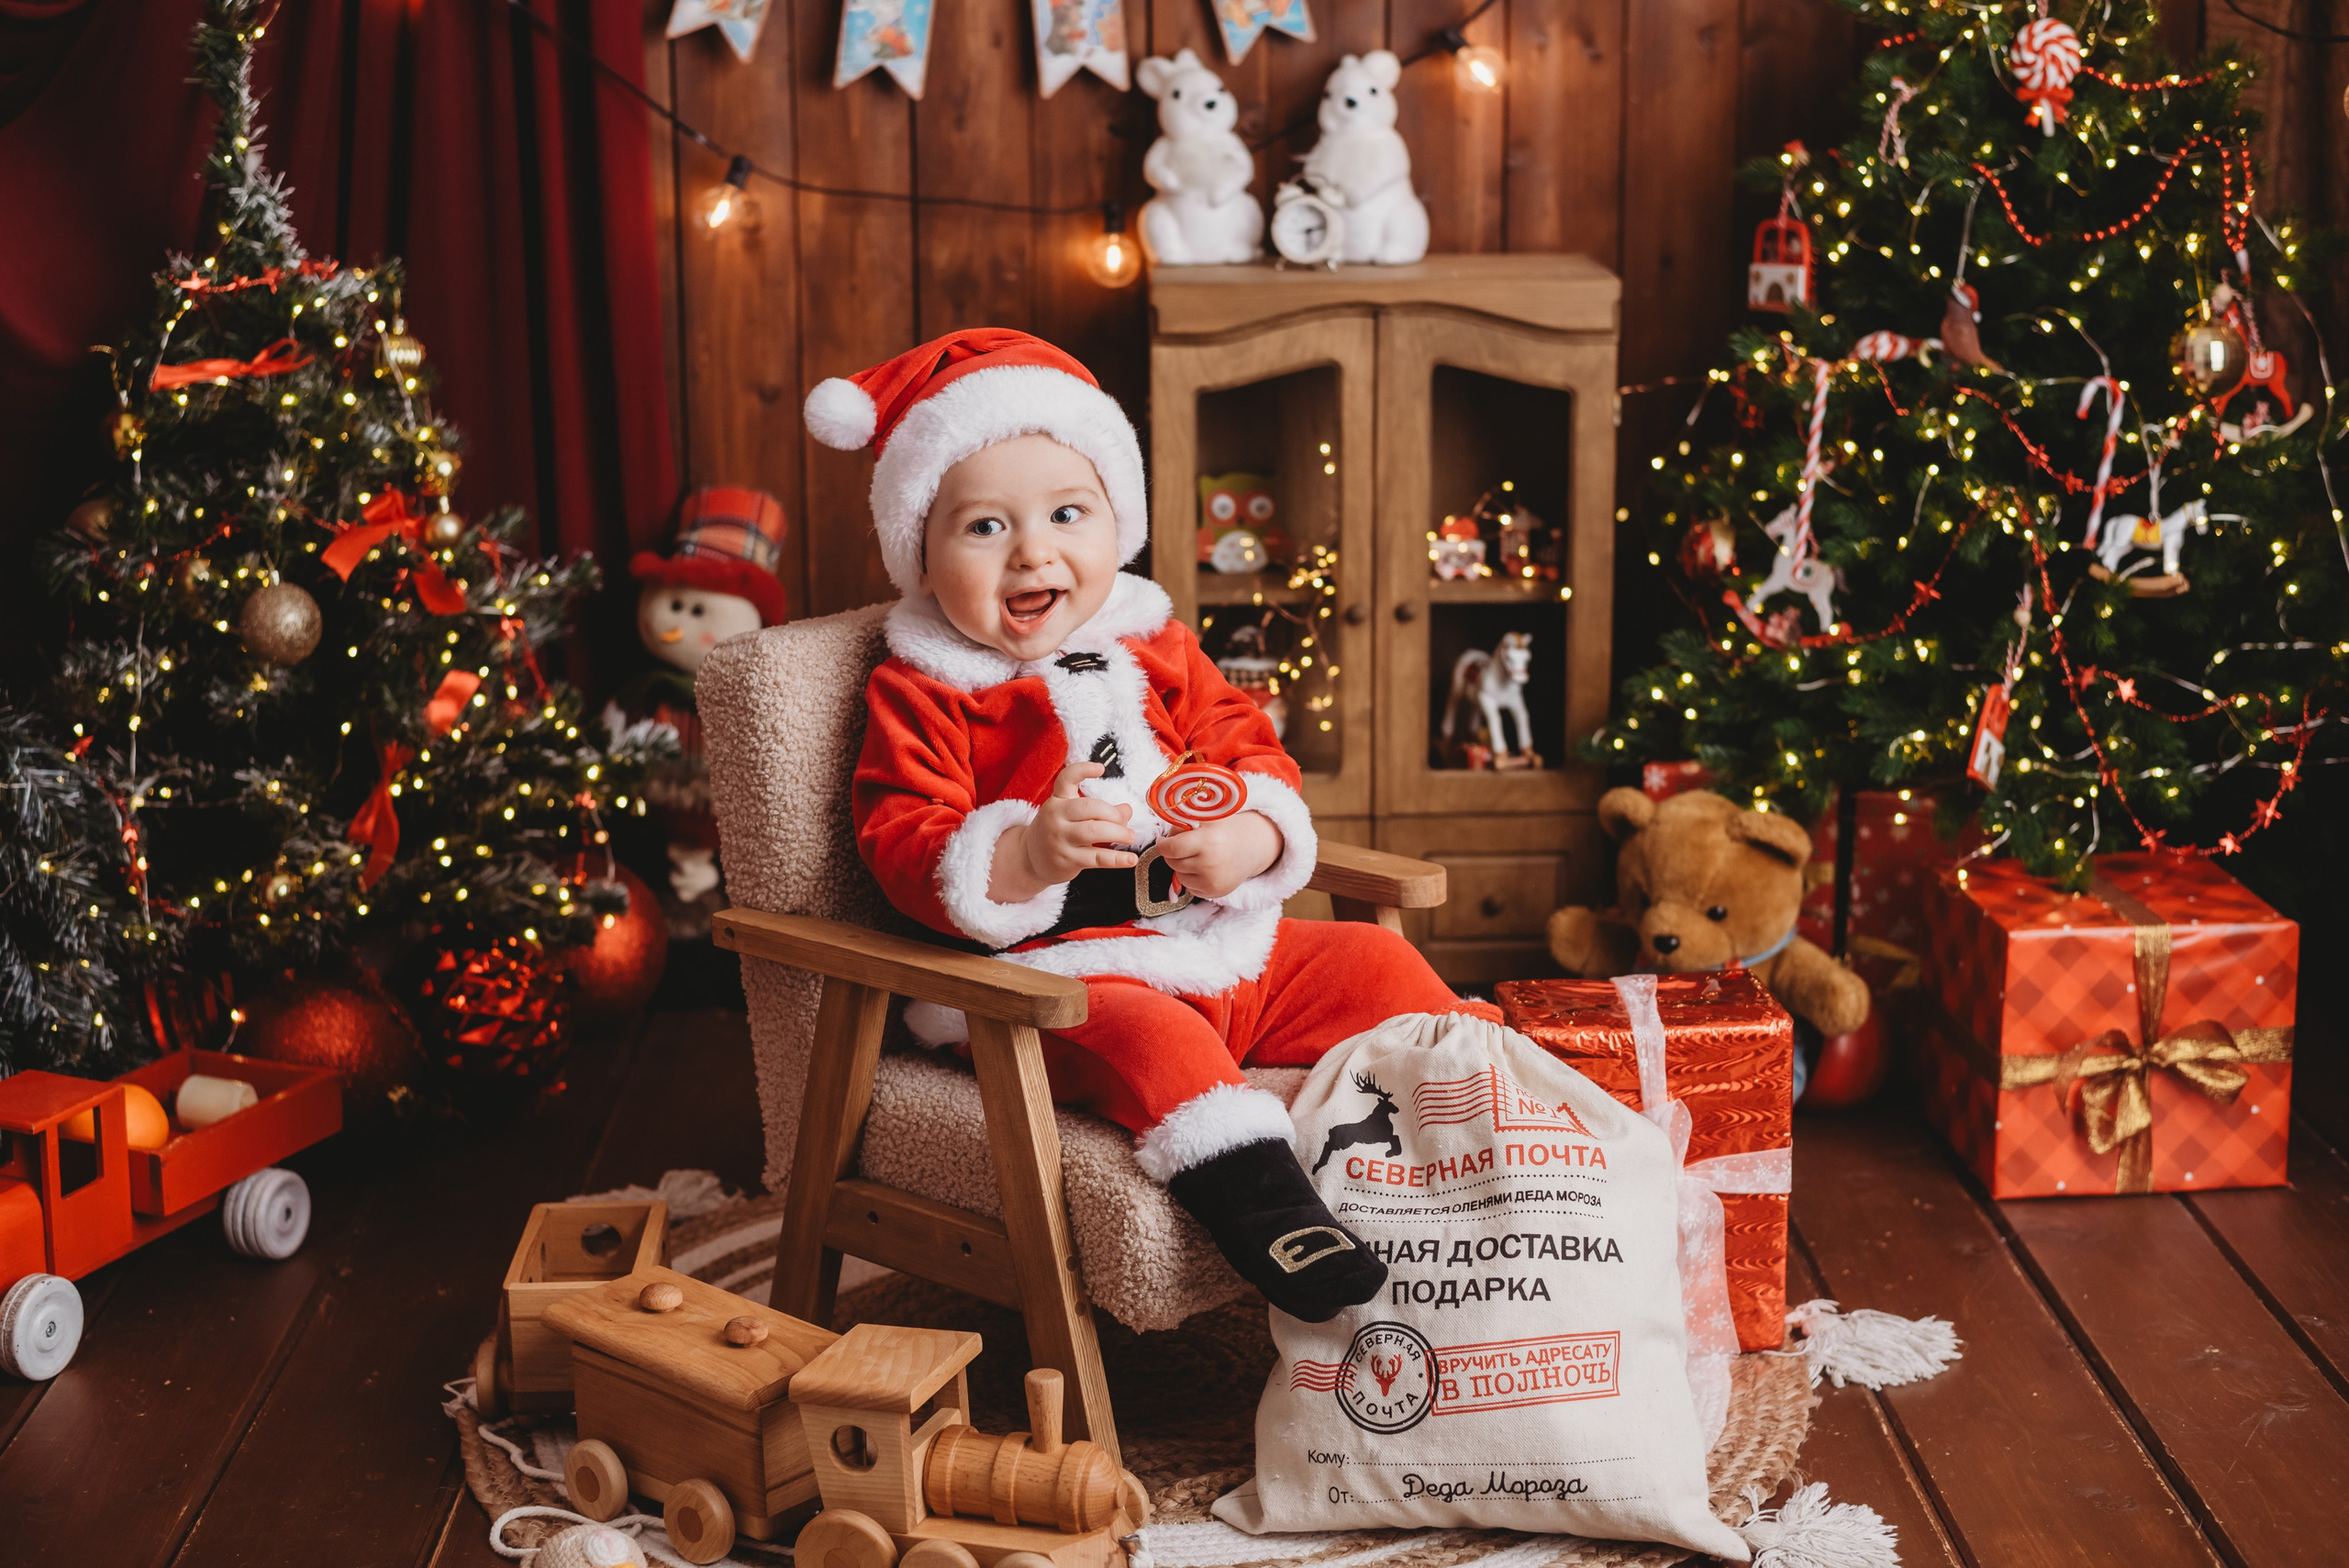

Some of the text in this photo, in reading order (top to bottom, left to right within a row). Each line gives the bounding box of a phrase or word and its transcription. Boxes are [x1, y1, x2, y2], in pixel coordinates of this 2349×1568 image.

[1345, 1144, 1607, 1187] СЕВЕРНАЯ ПОЧТА
[1339, 1190, 1602, 1216] ДОСТАВЛЯЕТСЯ ОЛЕНЯМИ ДЕДА МОРОЗА
[1366, 1233, 1624, 1267] НАЯ ДОСТАВКА
[1392, 1277, 1552, 1309] ПОДАРКА
[1355, 1333, 1421, 1363] СЕВЕРНАЯ
[1439, 1342, 1612, 1374] ВРУЧИТЬ АДРЕСАТУ
[1439, 1362, 1611, 1401] В ПОЛНОЧЬ
[1353, 1390, 1419, 1418] ПОЧТА
[1308, 1450, 1350, 1468] Кому:
[1329, 1471, 1588, 1504] От: Деда Мороза
